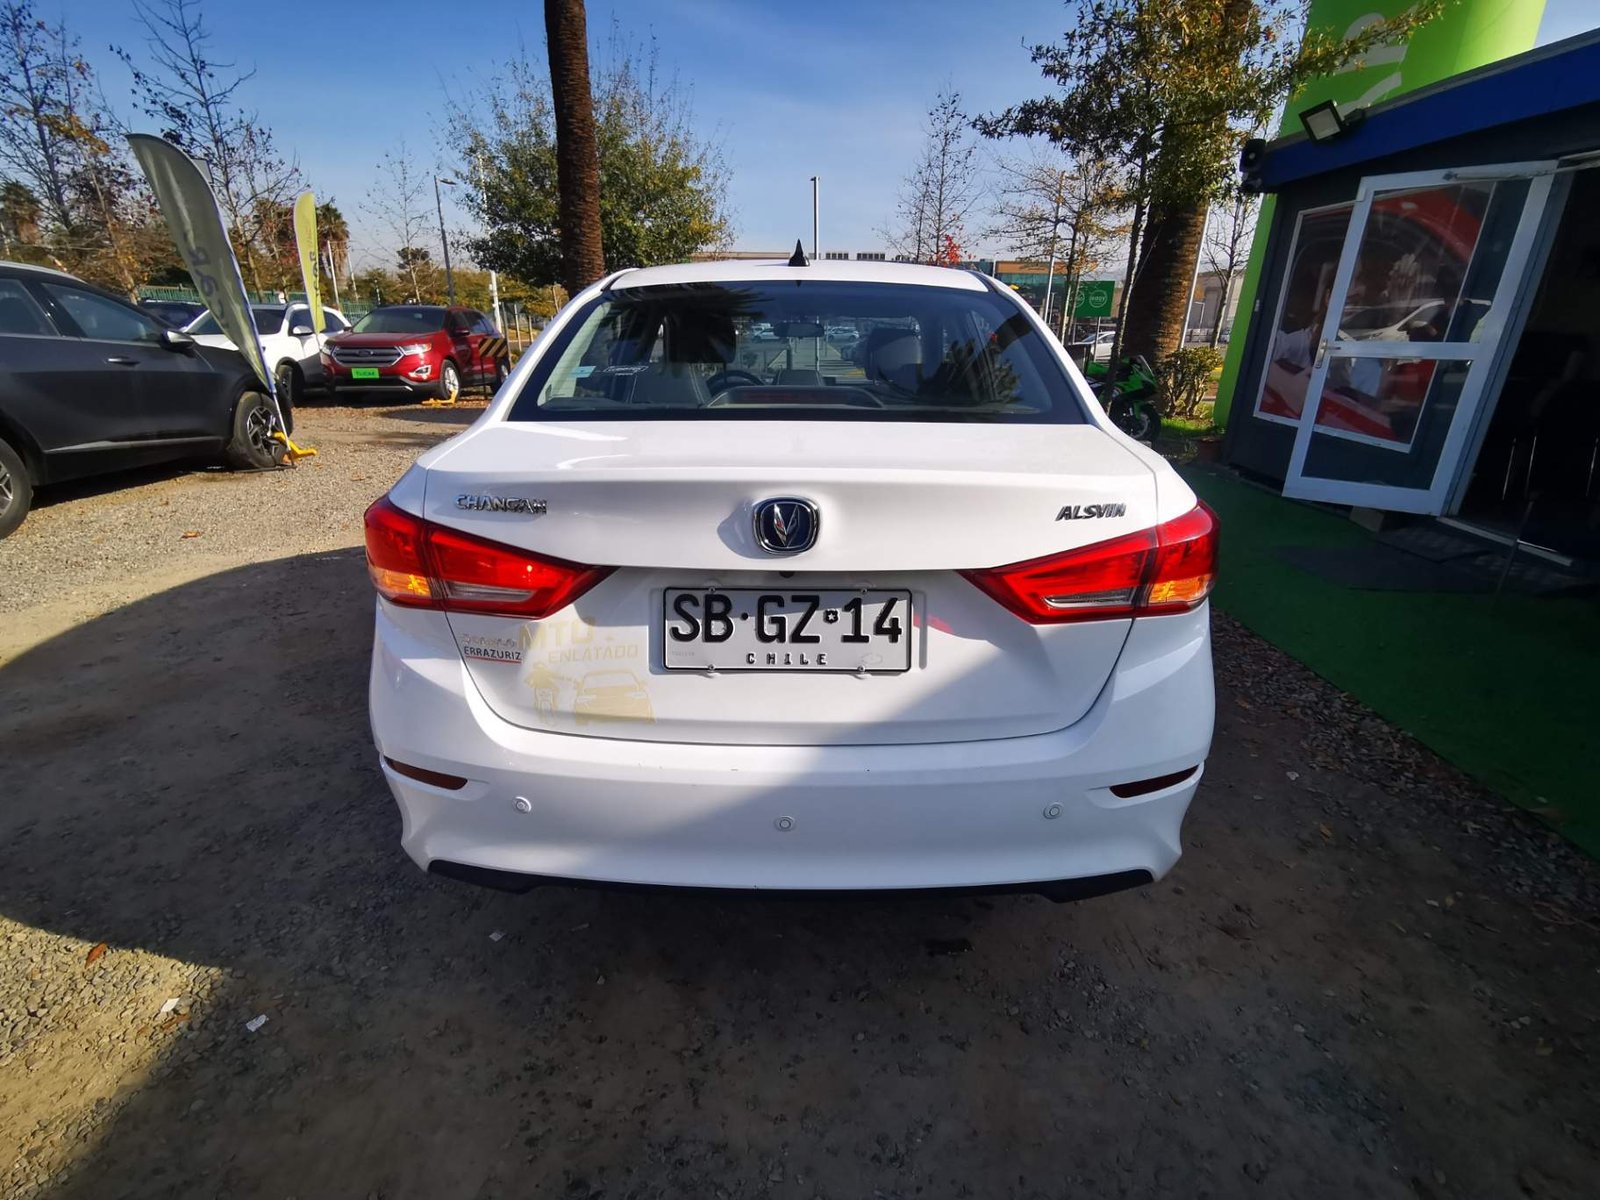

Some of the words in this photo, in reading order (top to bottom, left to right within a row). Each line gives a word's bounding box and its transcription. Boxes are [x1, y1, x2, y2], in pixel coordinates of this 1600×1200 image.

[456, 494, 547, 514] CHANGAN
[1055, 503, 1126, 521] ALSVIN
[464, 646, 522, 660] ERRAZURIZ
[745, 652, 827, 665] CHILE
